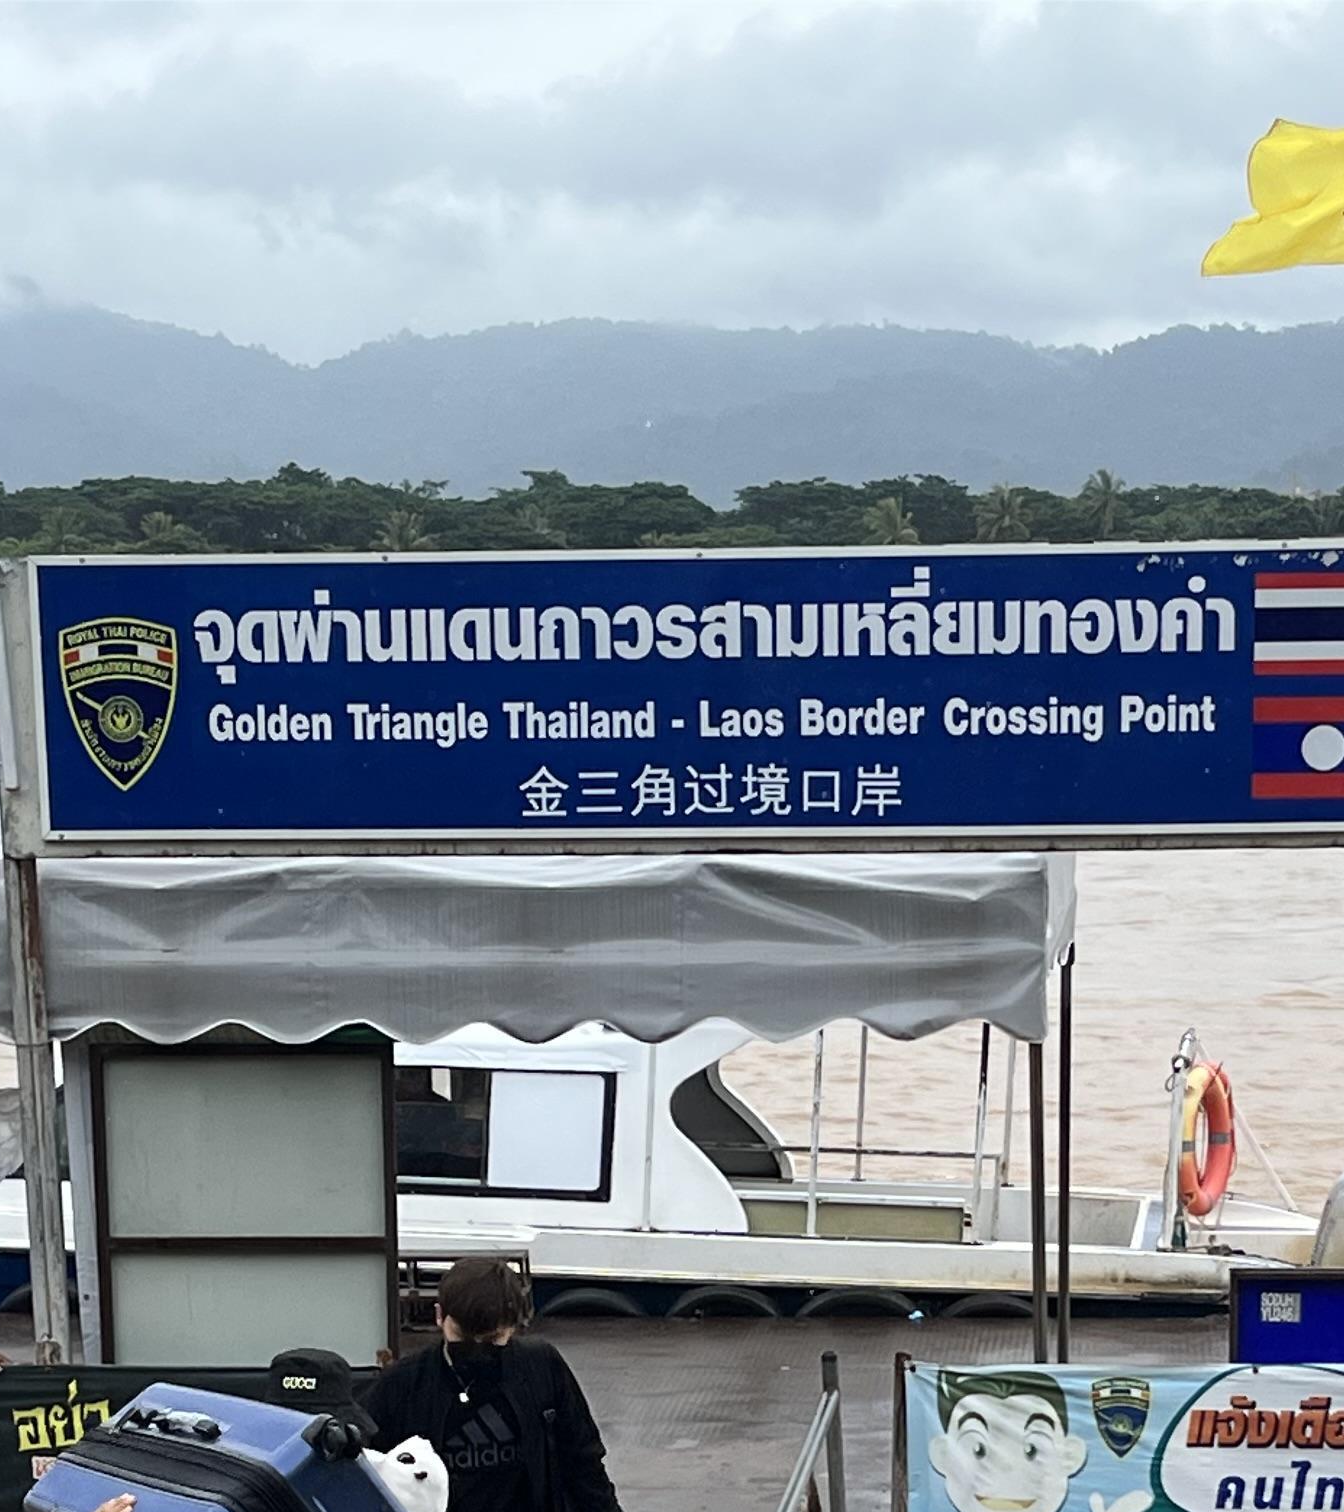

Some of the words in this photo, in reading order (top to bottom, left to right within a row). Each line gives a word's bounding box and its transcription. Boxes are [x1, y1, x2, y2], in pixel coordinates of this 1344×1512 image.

[66, 628, 100, 646] ROYAL
[102, 625, 128, 639] THAI
[130, 626, 168, 645] POLICE
[193, 566, 1237, 686] จุดผ่านแดนถาวรสามเหลี่ยมทองคำ
[132, 661, 170, 682] BUREAU
[209, 703, 333, 743] Golden
[346, 702, 490, 749] Triangle
[502, 702, 656, 740] Thailand
[700, 700, 785, 738] Laos
[801, 697, 926, 737] Border
[943, 696, 1106, 743] Crossing
[1120, 694, 1217, 734] Point
[519, 763, 903, 819] 金三角过境口岸
[446, 1441, 520, 1469] dida
